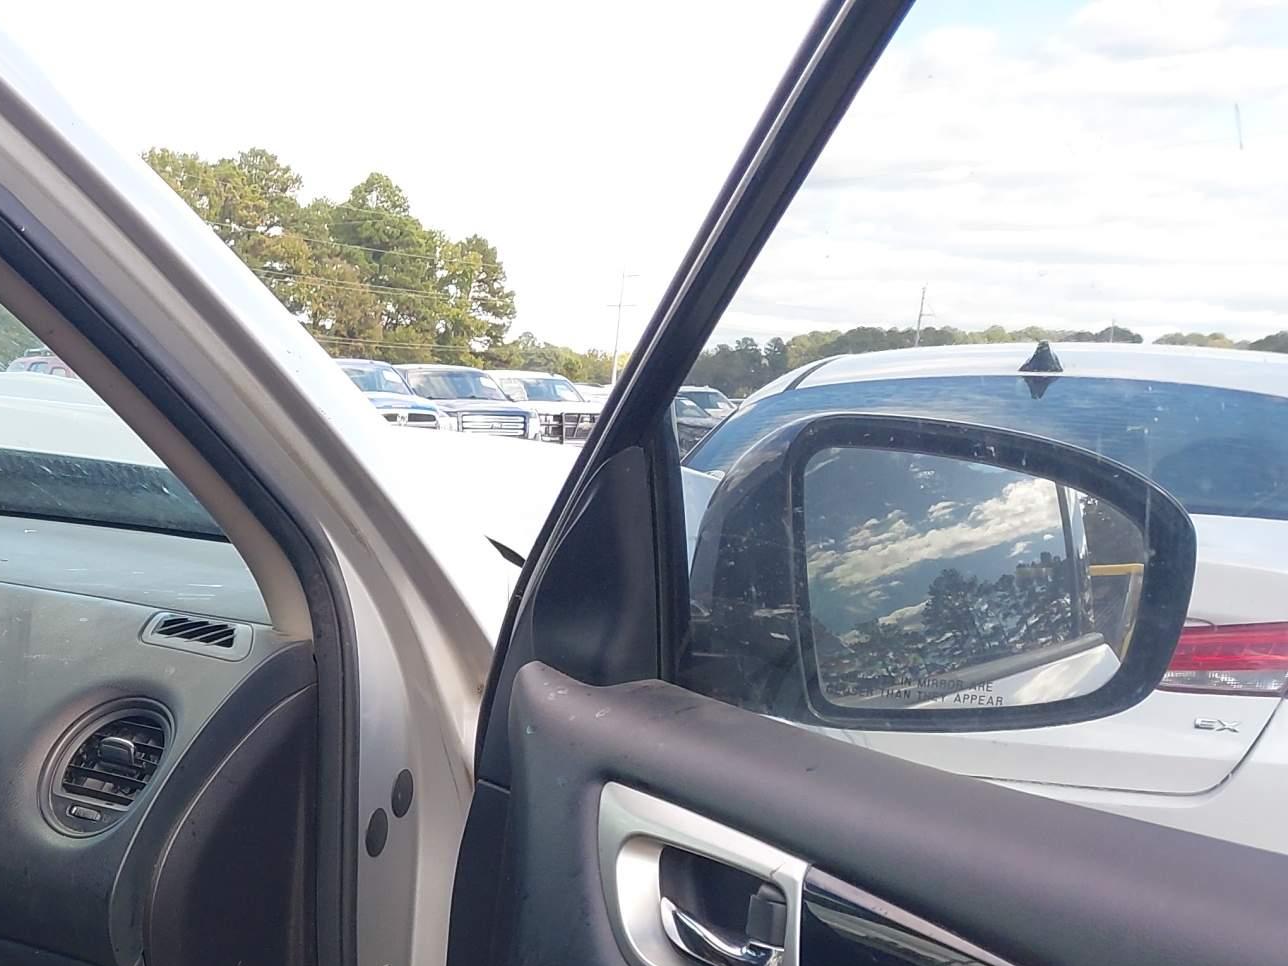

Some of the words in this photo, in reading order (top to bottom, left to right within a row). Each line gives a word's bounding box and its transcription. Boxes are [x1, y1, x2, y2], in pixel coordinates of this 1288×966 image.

[917, 679, 963, 690] MIRROR
[880, 689, 911, 699] THAN
[953, 695, 1004, 706] APPEAR
[1194, 718, 1240, 733] EX
